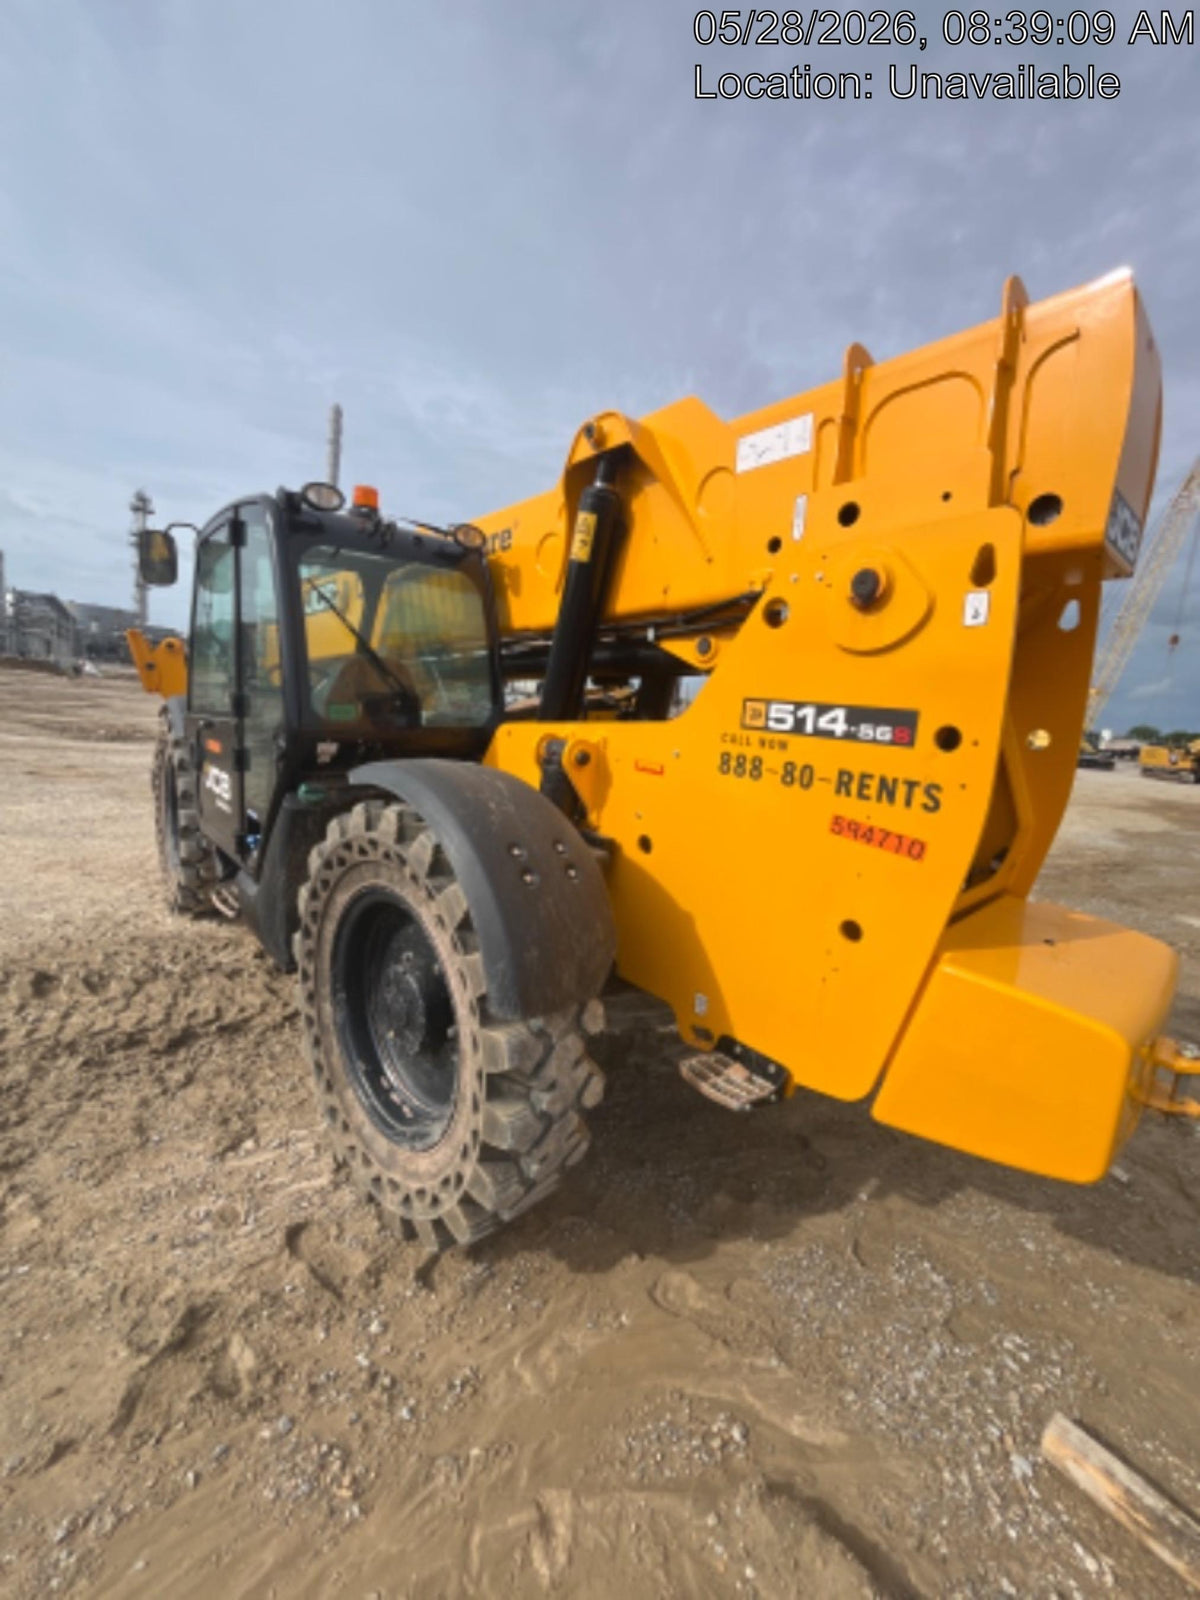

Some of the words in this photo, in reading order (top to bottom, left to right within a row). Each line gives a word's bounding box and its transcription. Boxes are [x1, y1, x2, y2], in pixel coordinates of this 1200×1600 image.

[720, 731, 752, 748] CALL
[758, 735, 790, 752] NOW
[717, 750, 943, 814] 888-80-RENTS
